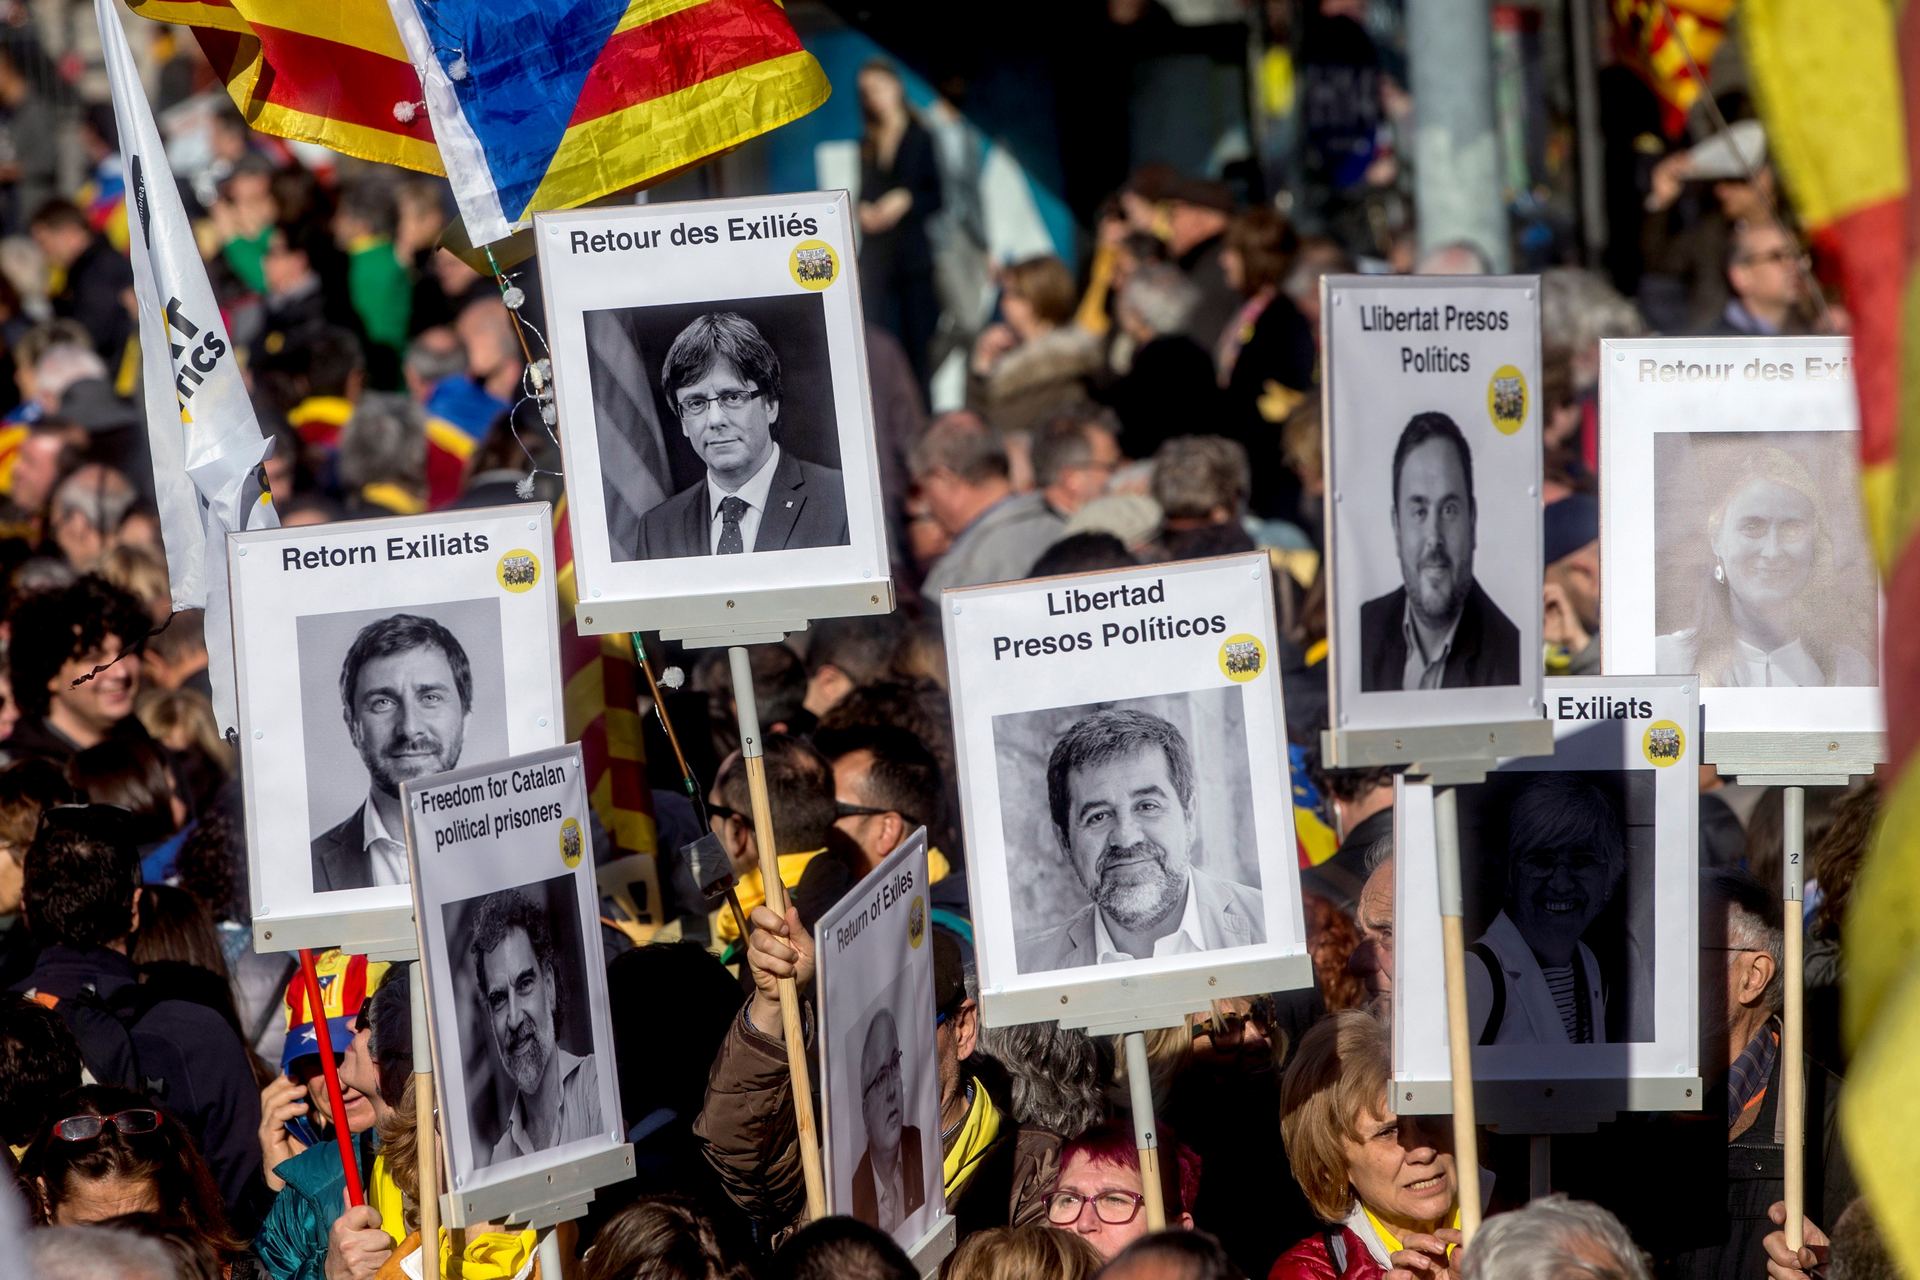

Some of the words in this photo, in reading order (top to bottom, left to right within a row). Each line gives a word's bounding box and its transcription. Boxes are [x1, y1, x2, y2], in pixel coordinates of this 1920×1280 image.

[570, 229, 662, 255] Retour
[670, 222, 719, 247] des
[727, 212, 818, 242] Exiliés
[1360, 304, 1440, 332] Llibertat
[1445, 304, 1510, 332] Presos
[177, 331, 226, 413] TICS
[1400, 345, 1471, 374] Polítics
[1638, 358, 1734, 383] Retour
[1743, 358, 1795, 382] des
[1804, 356, 1854, 382] Exi
[283, 545, 377, 572] Retorn
[386, 531, 490, 561] Exiliats
[1047, 578, 1165, 617] Libertad
[993, 631, 1093, 661] Presos
[1101, 614, 1227, 648] Políticos
[1557, 695, 1654, 720] Exiliats
[419, 783, 486, 815] Freedom
[487, 776, 508, 800] for
[511, 764, 567, 794] Catalan
[434, 813, 491, 853] political
[494, 802, 563, 840] prisoners
[836, 908, 869, 954] Return
[870, 891, 881, 921] of
[882, 870, 914, 911] Exiles
